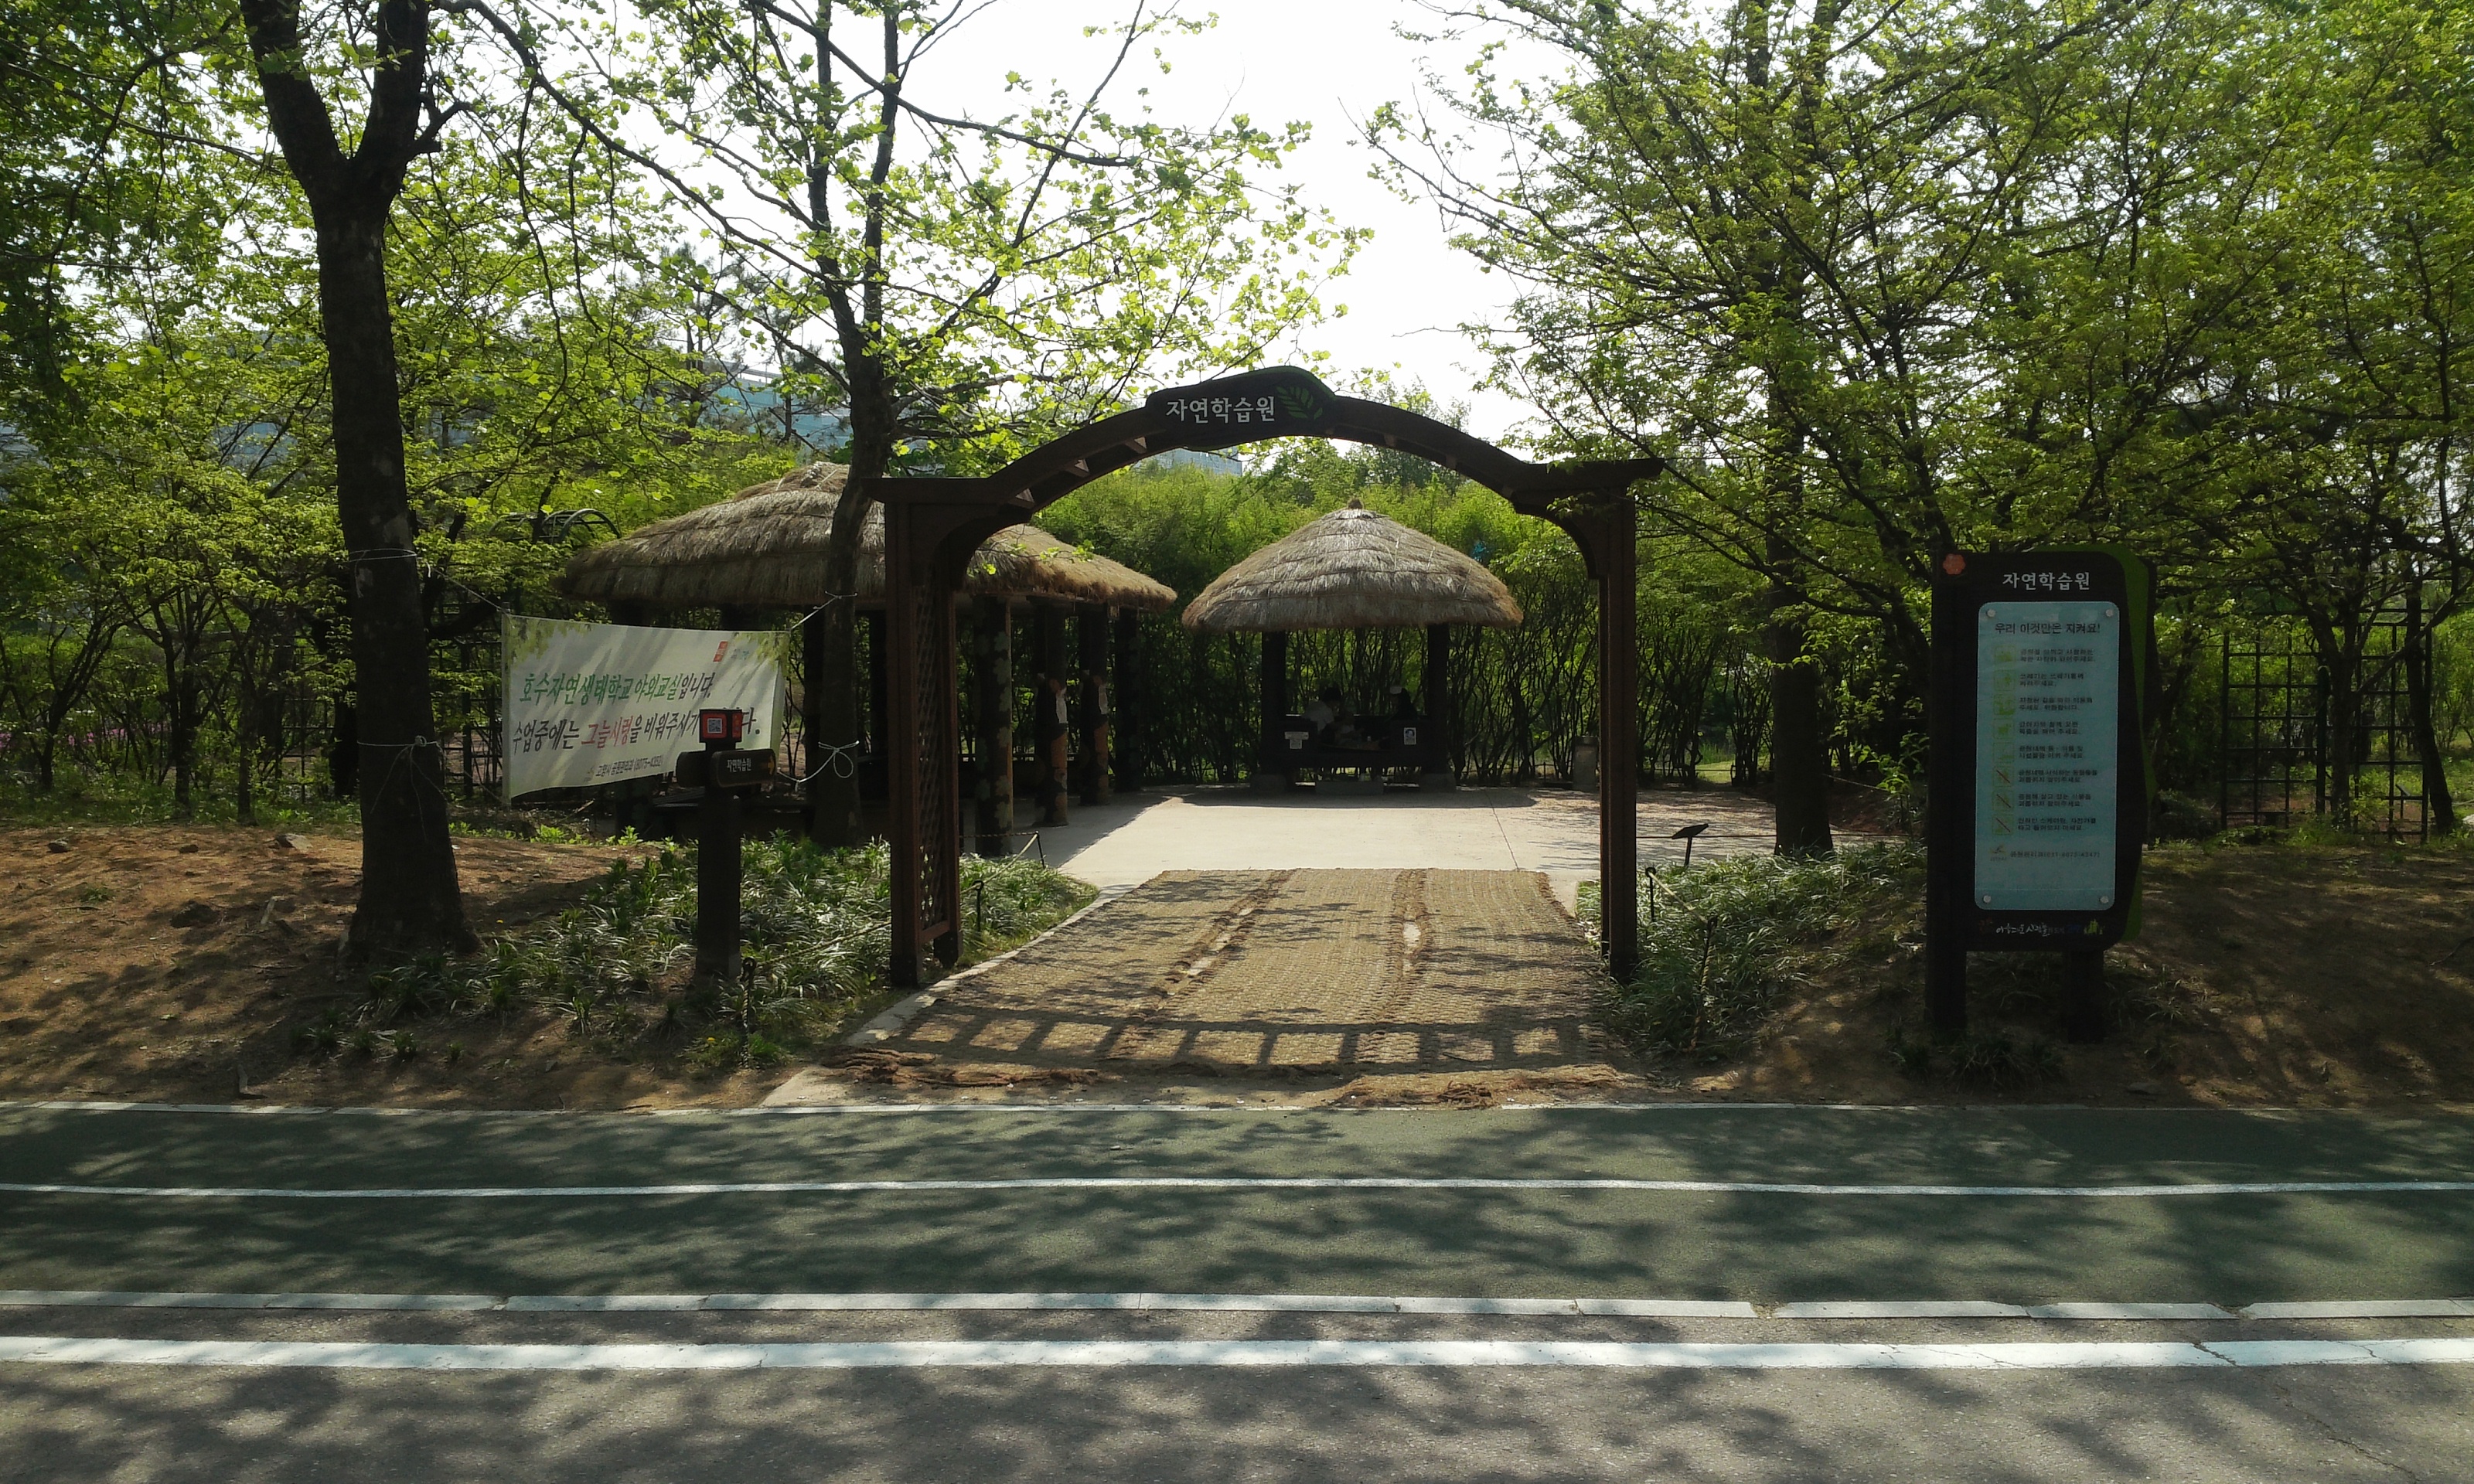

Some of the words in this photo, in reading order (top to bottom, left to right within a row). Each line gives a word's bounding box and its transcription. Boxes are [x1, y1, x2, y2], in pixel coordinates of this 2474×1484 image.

[1165, 395, 1275, 424] 자연학습원
[2002, 572, 2090, 591] 자연학습원
[1995, 622, 2016, 634] 우리
[2020, 622, 2062, 635] 이것만은
[2066, 622, 2101, 635] 지켜요!
[519, 672, 634, 706] 호수자연생태학교
[634, 672, 716, 703] 야외교실입니다.
[512, 719, 580, 755] 수업중에는
[643, 710, 700, 742] 비워주시기
